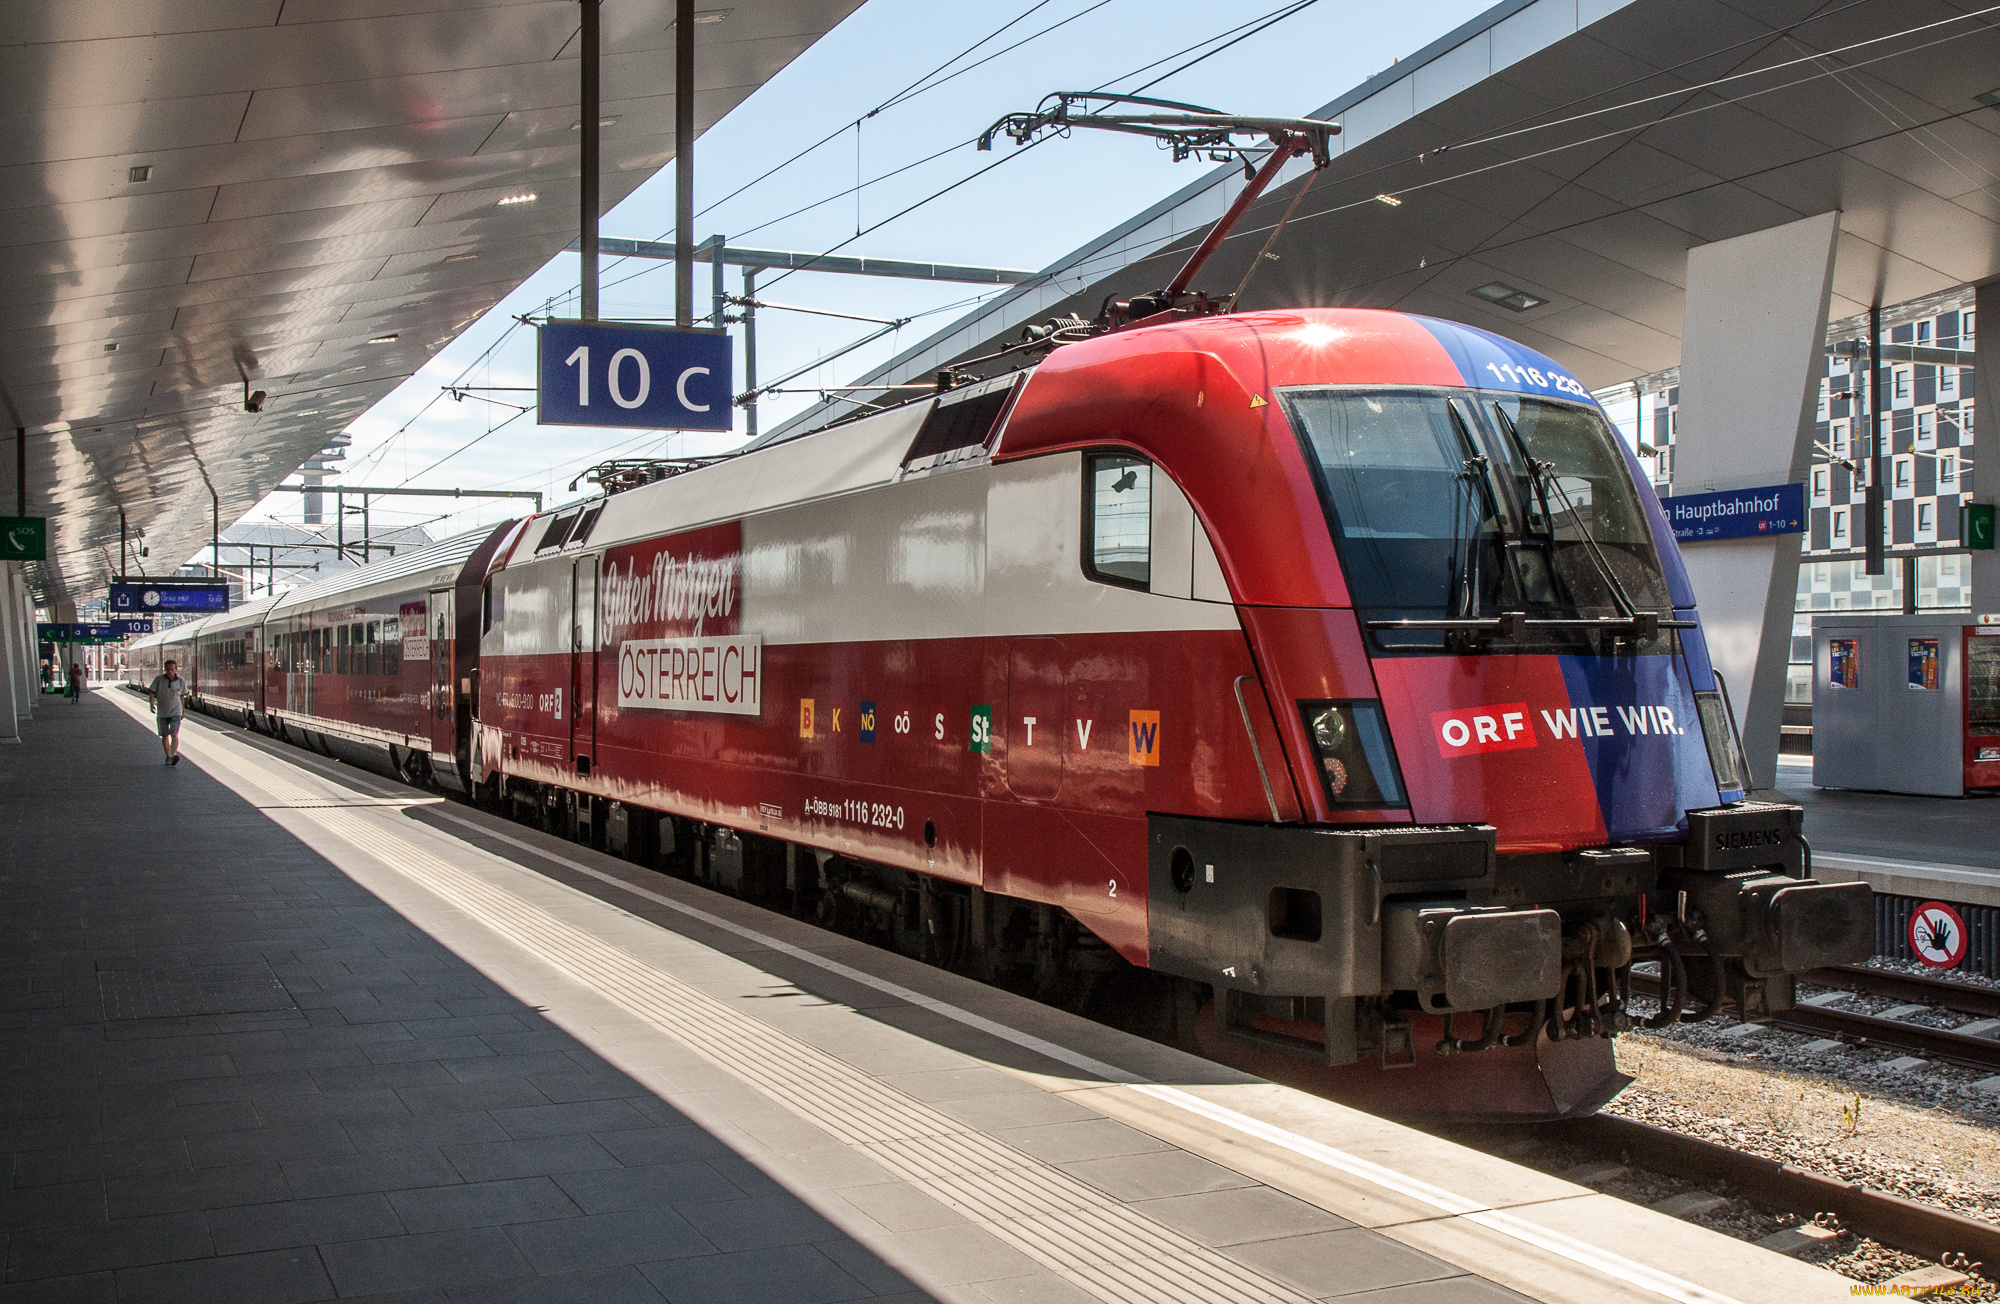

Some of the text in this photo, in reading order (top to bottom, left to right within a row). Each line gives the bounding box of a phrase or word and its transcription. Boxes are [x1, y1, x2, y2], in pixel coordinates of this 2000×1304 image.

[564, 345, 651, 409] 10
[1486, 362, 1591, 399] 1116 232
[1675, 493, 1780, 522] Hauptbahnhof
[16, 527, 35, 535] SOS
[1768, 520, 1786, 529] 1-10
[603, 550, 735, 646] Guten Morgen
[127, 622, 141, 631] 10
[620, 644, 757, 703] ÖSTERREICH
[539, 693, 554, 712] ORF
[803, 706, 1157, 754] B K NÖ OÖ S St T V W
[1441, 705, 1684, 747] ORF WIE WIR.
[805, 797, 828, 816] A-ÖBB
[828, 803, 842, 819] 9181
[844, 798, 868, 824] 1116
[871, 802, 904, 830] 232-0
[1716, 829, 1780, 851] SIEMENS
[1109, 879, 1117, 898] 2
